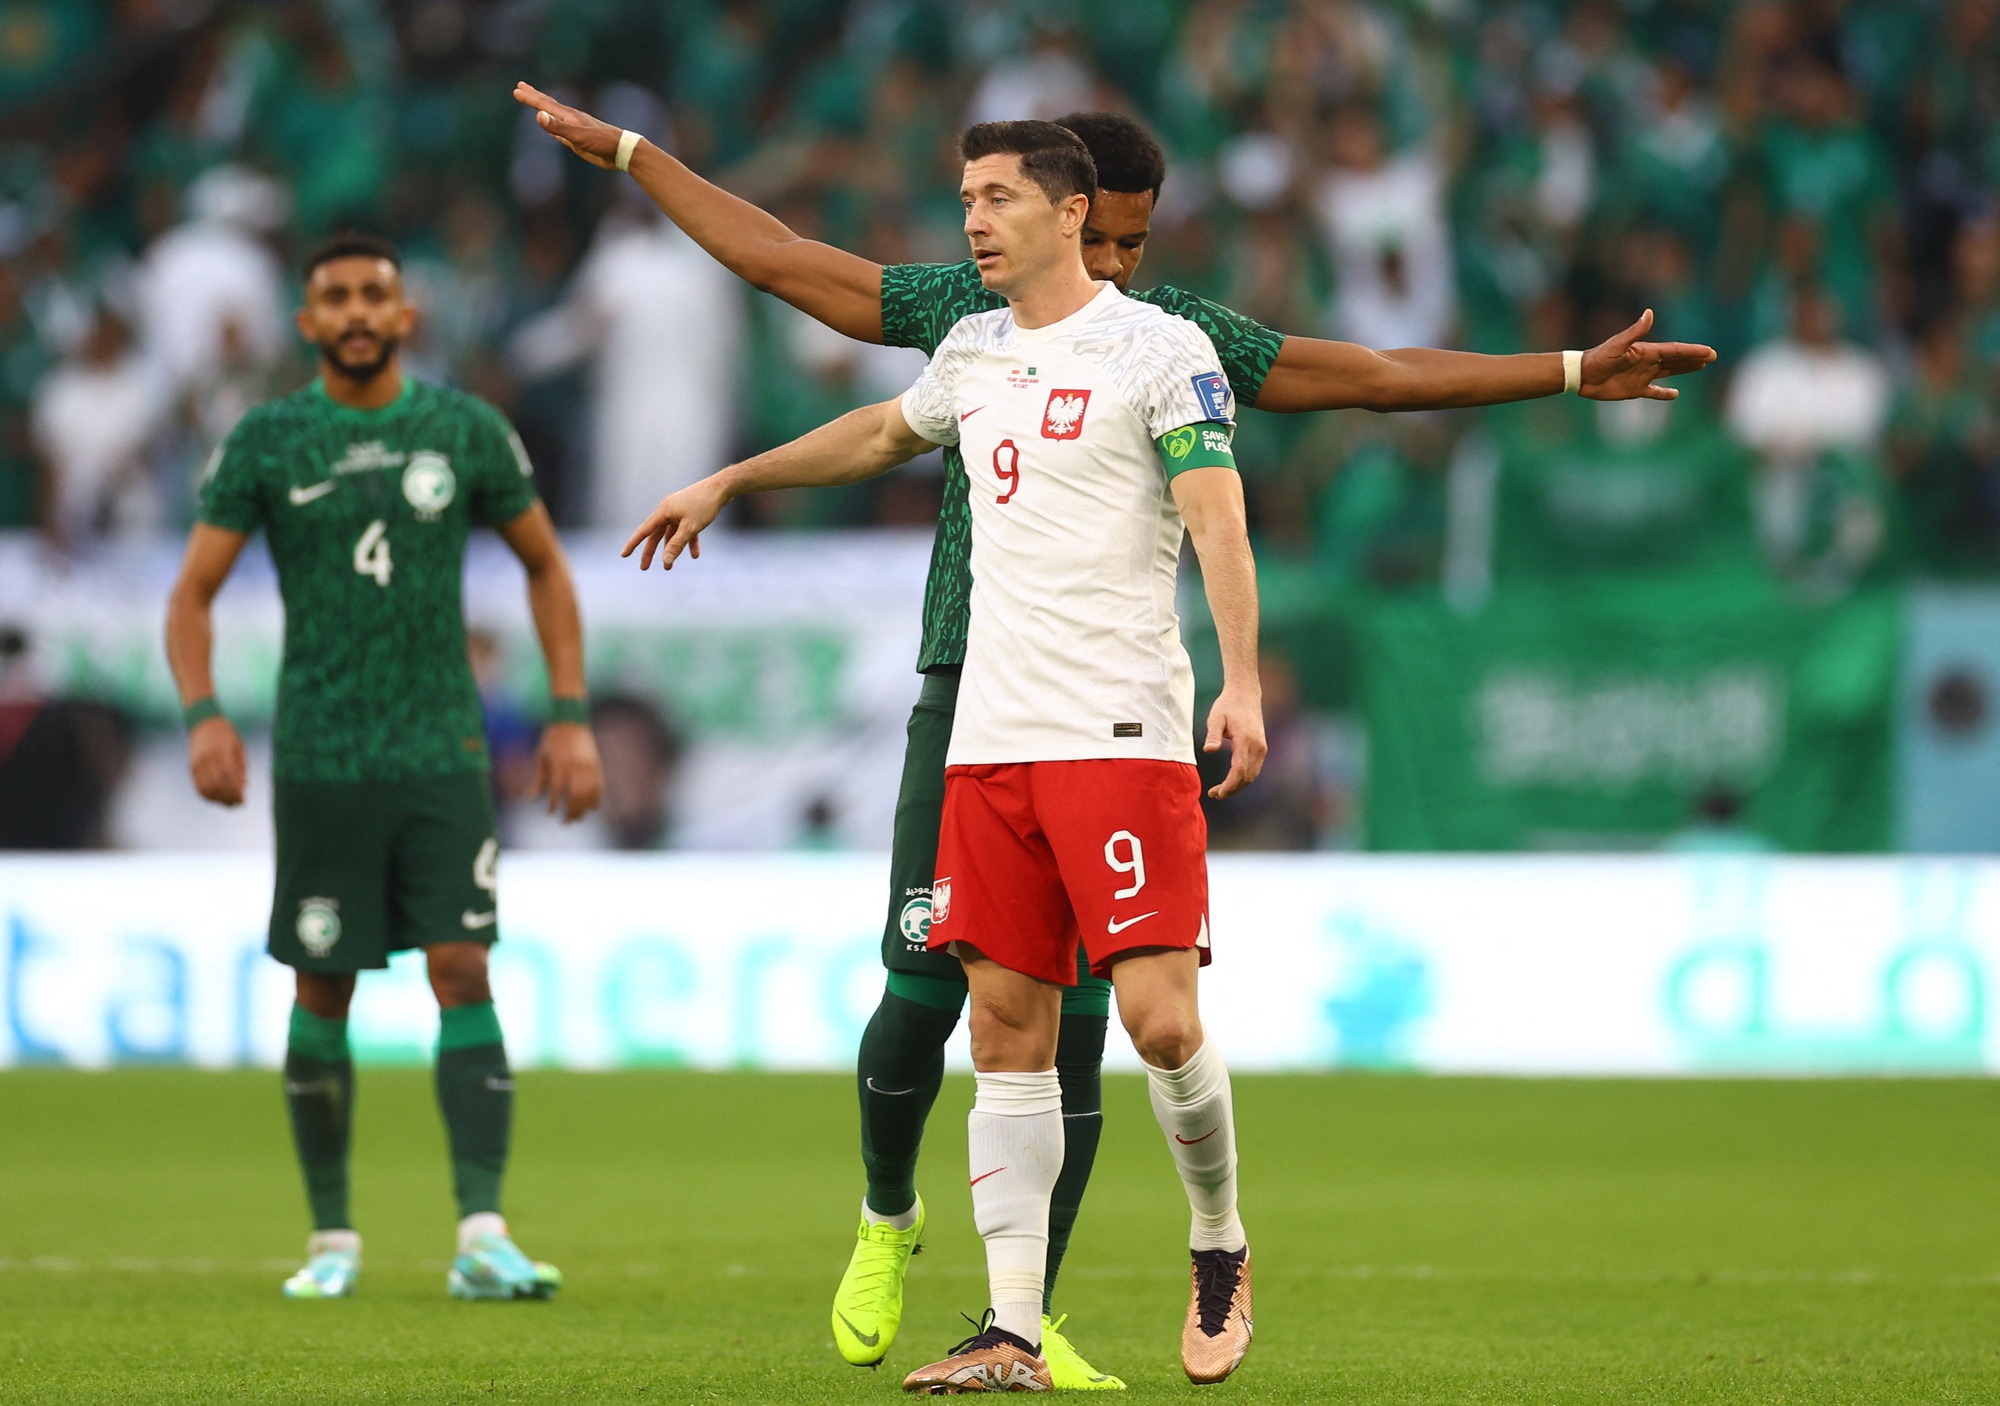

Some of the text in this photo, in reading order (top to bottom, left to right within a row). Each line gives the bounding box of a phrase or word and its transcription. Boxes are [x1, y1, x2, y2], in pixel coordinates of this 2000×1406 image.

[1202, 430, 1226, 443] SAVE
[993, 438, 1020, 504] 9
[353, 519, 394, 587] 4
[1104, 829, 1147, 901] 9
[906, 943, 927, 952] KSA
